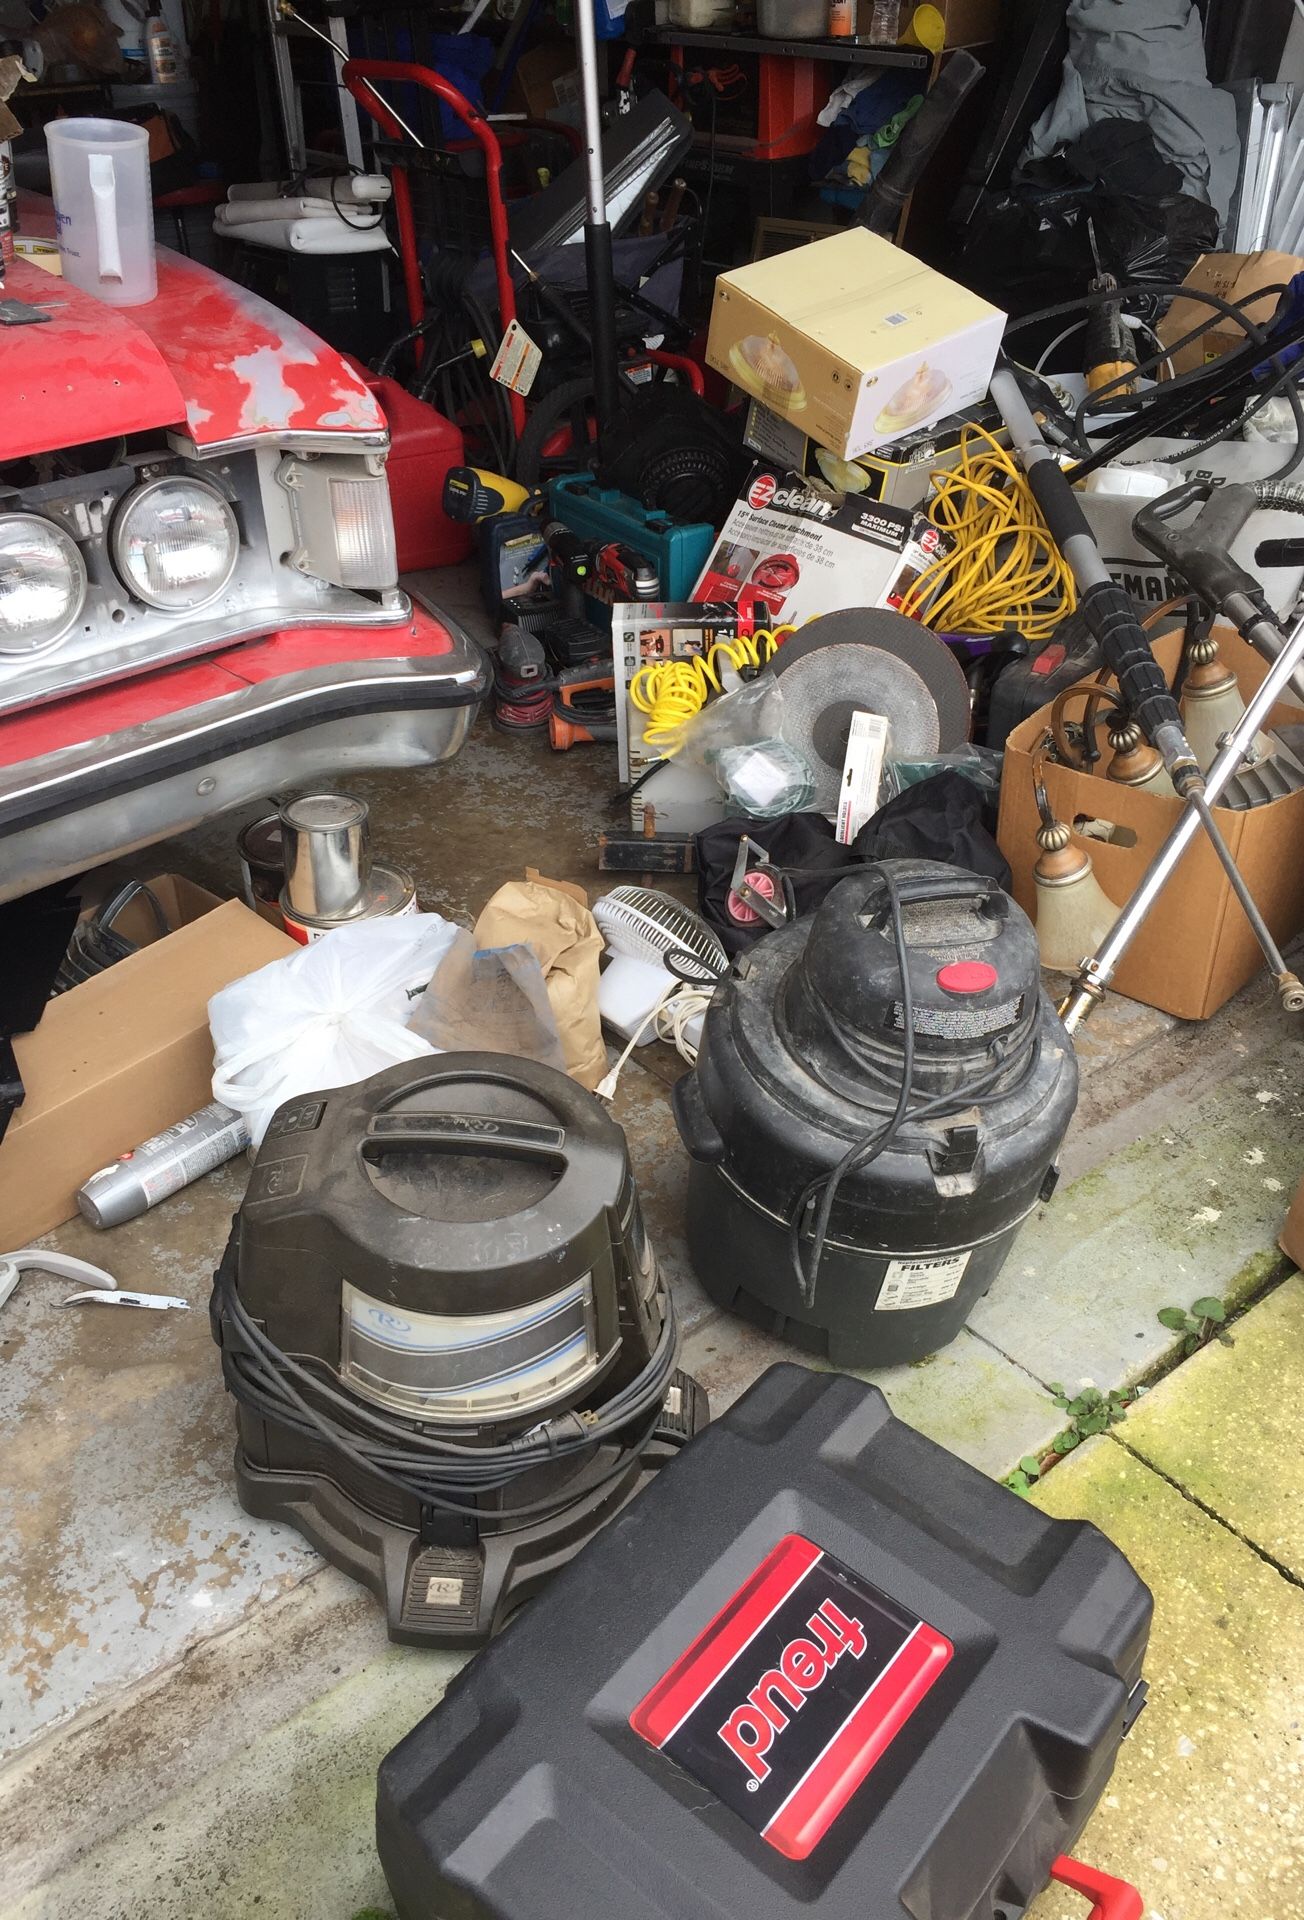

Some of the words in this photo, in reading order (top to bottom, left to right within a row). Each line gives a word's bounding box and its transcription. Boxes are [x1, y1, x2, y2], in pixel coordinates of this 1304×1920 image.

[773, 488, 832, 516] clean
[860, 512, 888, 529] 3300
[887, 519, 906, 533] PSI
[860, 519, 900, 538] MAXIMUM
[787, 524, 823, 542] Attachment
[900, 1257, 961, 1272] FILTERS
